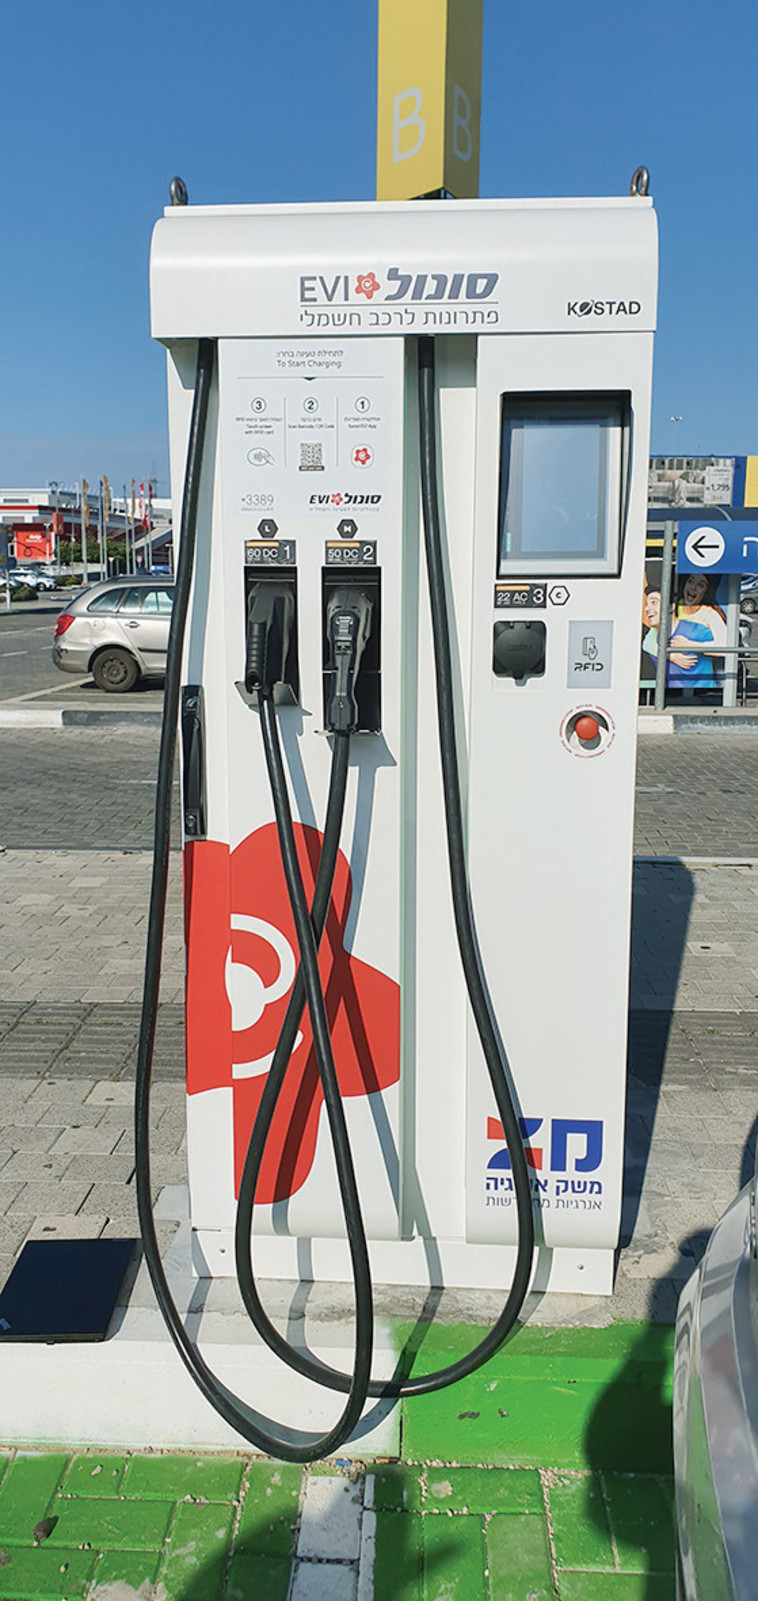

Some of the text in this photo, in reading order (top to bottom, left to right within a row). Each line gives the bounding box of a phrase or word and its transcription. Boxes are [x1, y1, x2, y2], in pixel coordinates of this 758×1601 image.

[393, 86, 426, 165] B
[453, 83, 472, 163] B
[299, 266, 499, 302] סונול EVI
[567, 299, 641, 317] KOSTAD
[300, 308, 499, 327] פתרונות לרכב חשמלי
[277, 359, 286, 368] To
[287, 359, 306, 368] Start
[255, 400, 262, 410] 3
[307, 400, 314, 410] 2
[360, 400, 365, 410] 1
[309, 492, 382, 505] סונול EVI
[247, 545, 290, 559] 60 DC 1
[328, 545, 373, 560] 50 DC 2
[497, 592, 510, 602] 22
[513, 592, 528, 602] AC
[532, 588, 544, 604] 3
[574, 662, 604, 672] RFID
[555, 1178, 603, 1197] משק
[555, 1198, 602, 1210] אנרגיות
